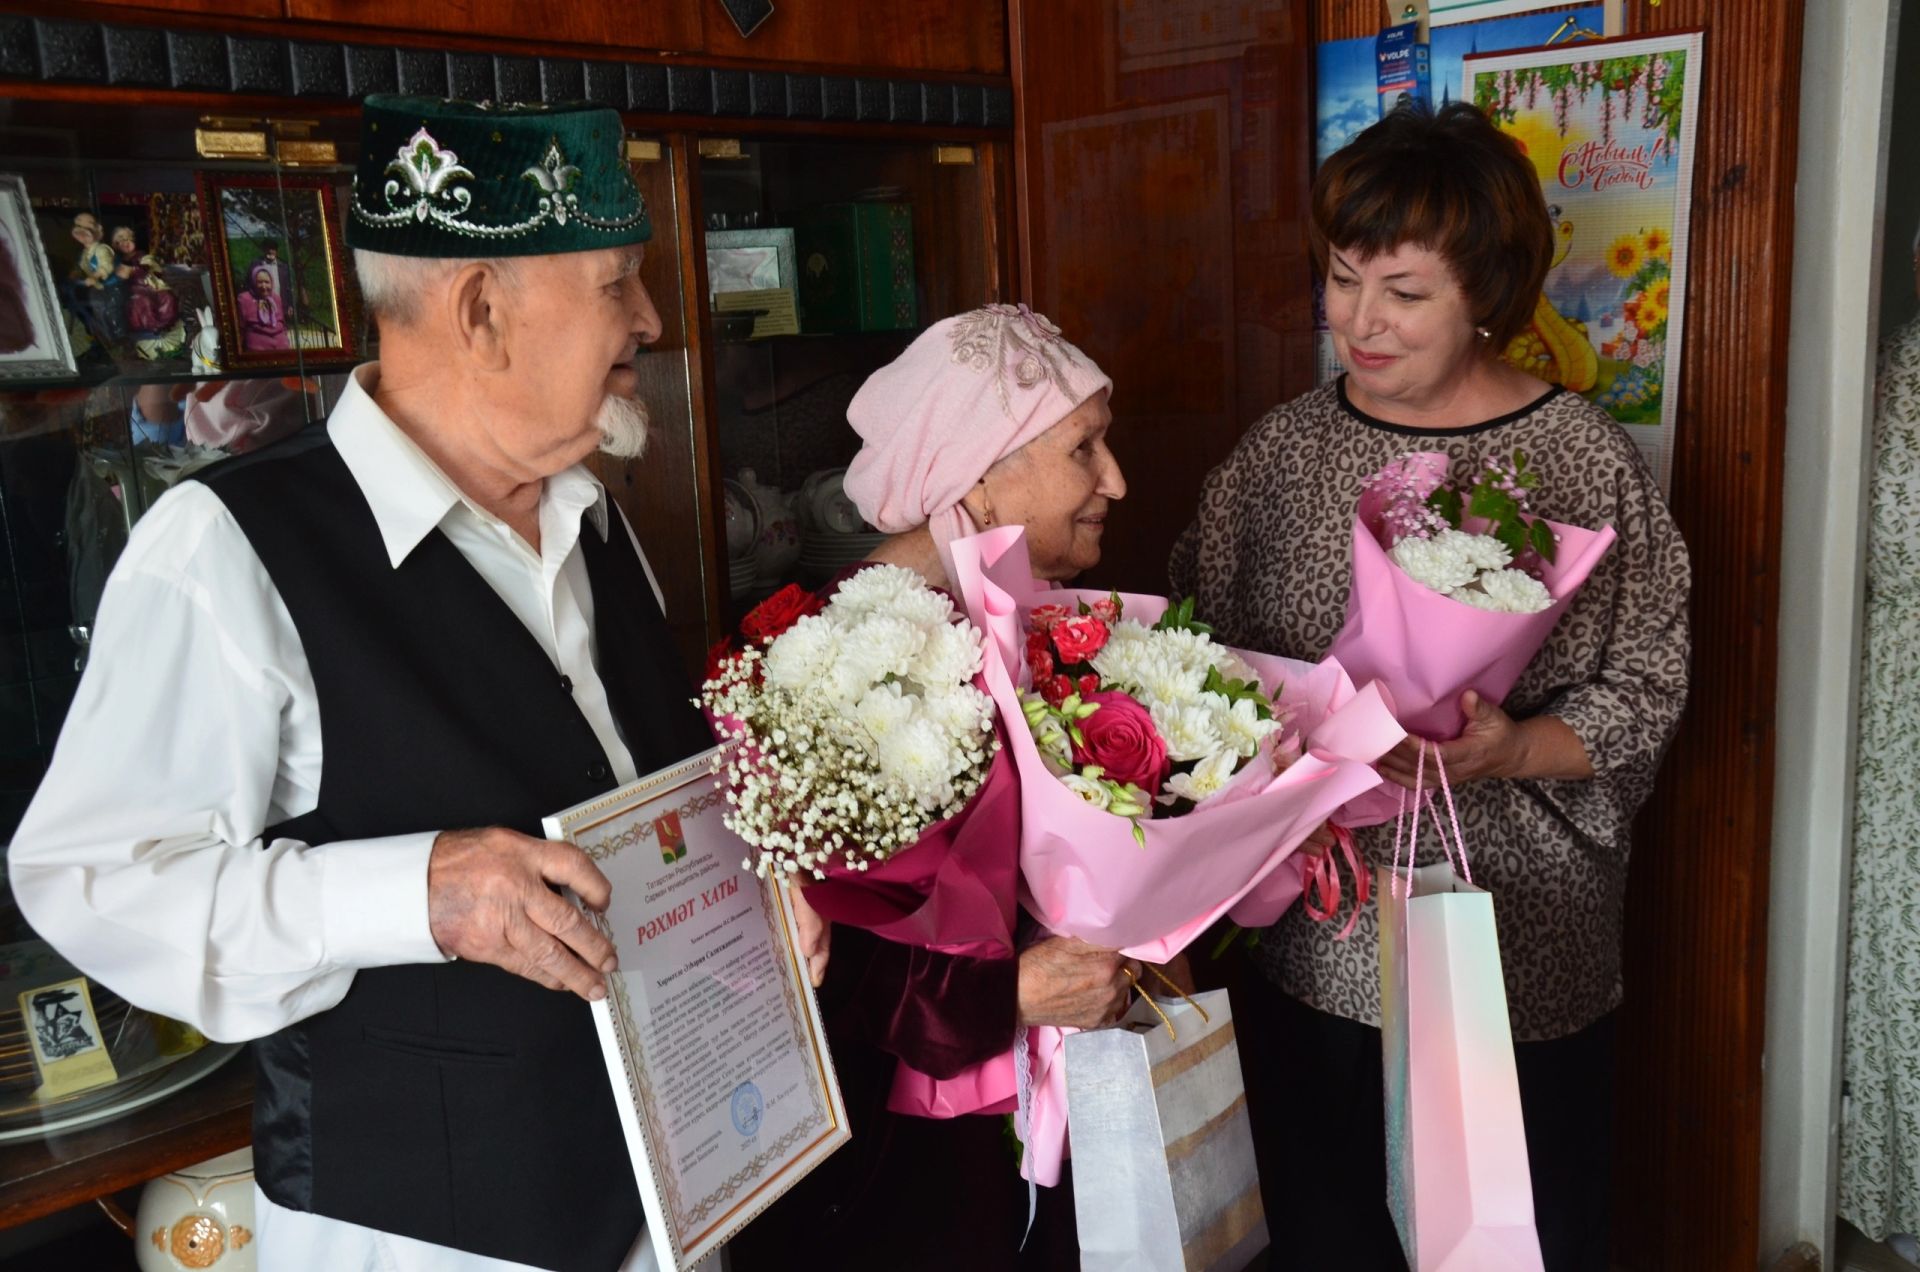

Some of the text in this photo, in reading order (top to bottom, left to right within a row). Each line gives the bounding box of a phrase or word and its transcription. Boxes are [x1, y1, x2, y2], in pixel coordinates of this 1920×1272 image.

[1386, 48, 1410, 61] VOLPE
[646, 870, 675, 890] Татарстан
[636, 897, 696, 945] РӘХМӘТ
[700, 875, 739, 910] ХАТЫ
